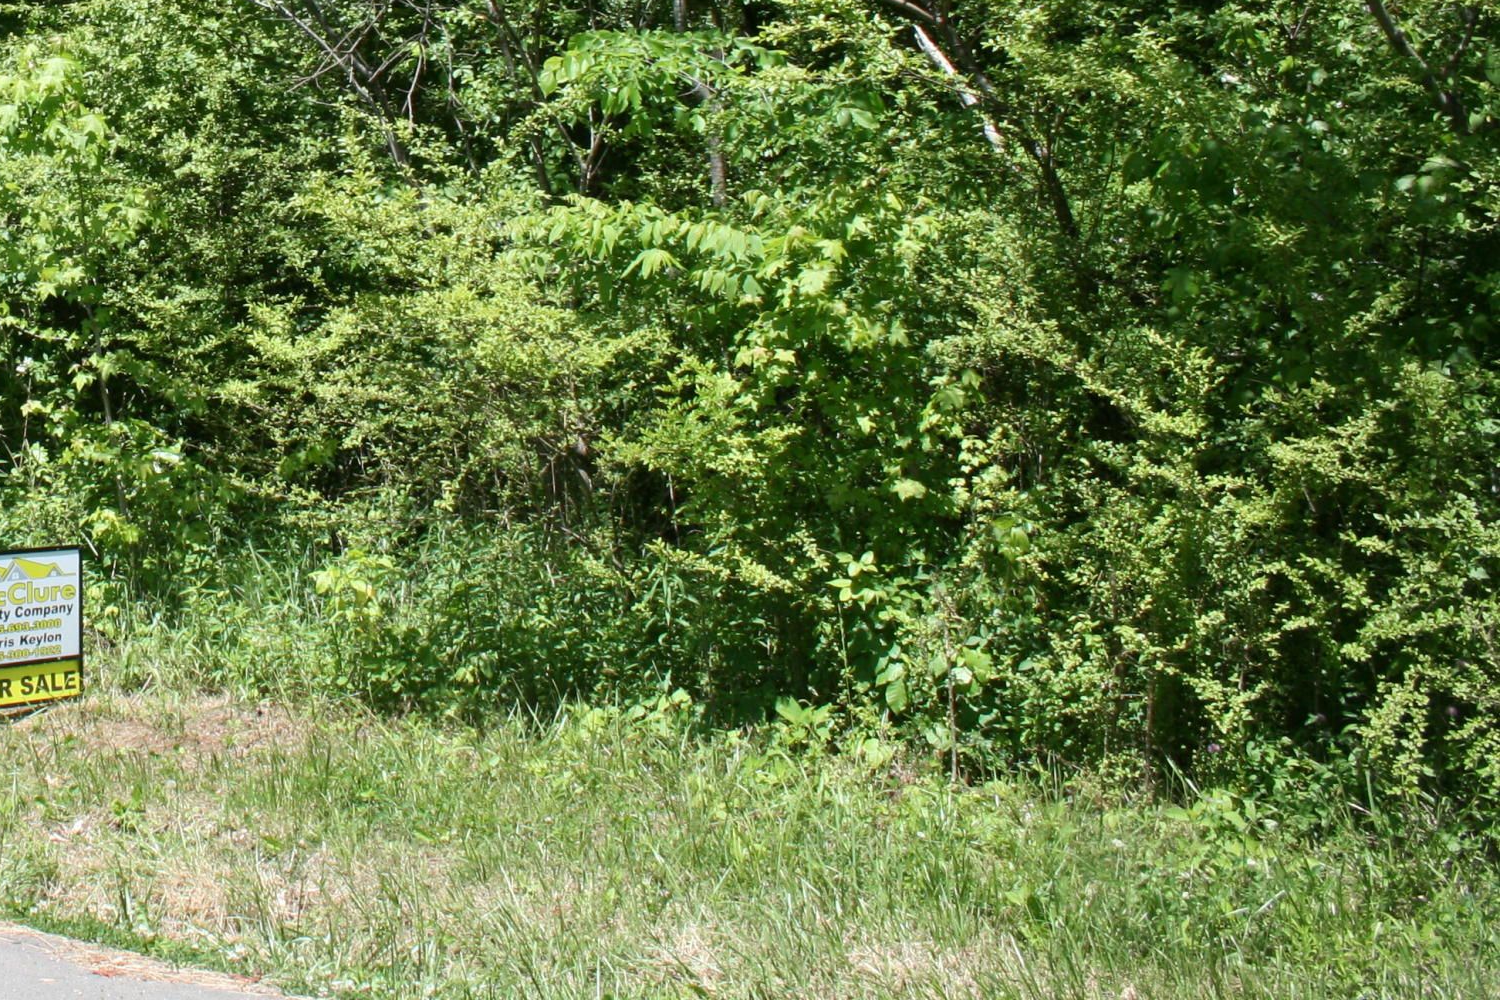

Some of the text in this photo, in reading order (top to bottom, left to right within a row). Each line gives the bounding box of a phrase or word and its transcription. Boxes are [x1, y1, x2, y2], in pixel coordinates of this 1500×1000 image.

[15, 603, 74, 618] Company
[19, 632, 62, 647] Keylon
[20, 670, 77, 696] SALE
